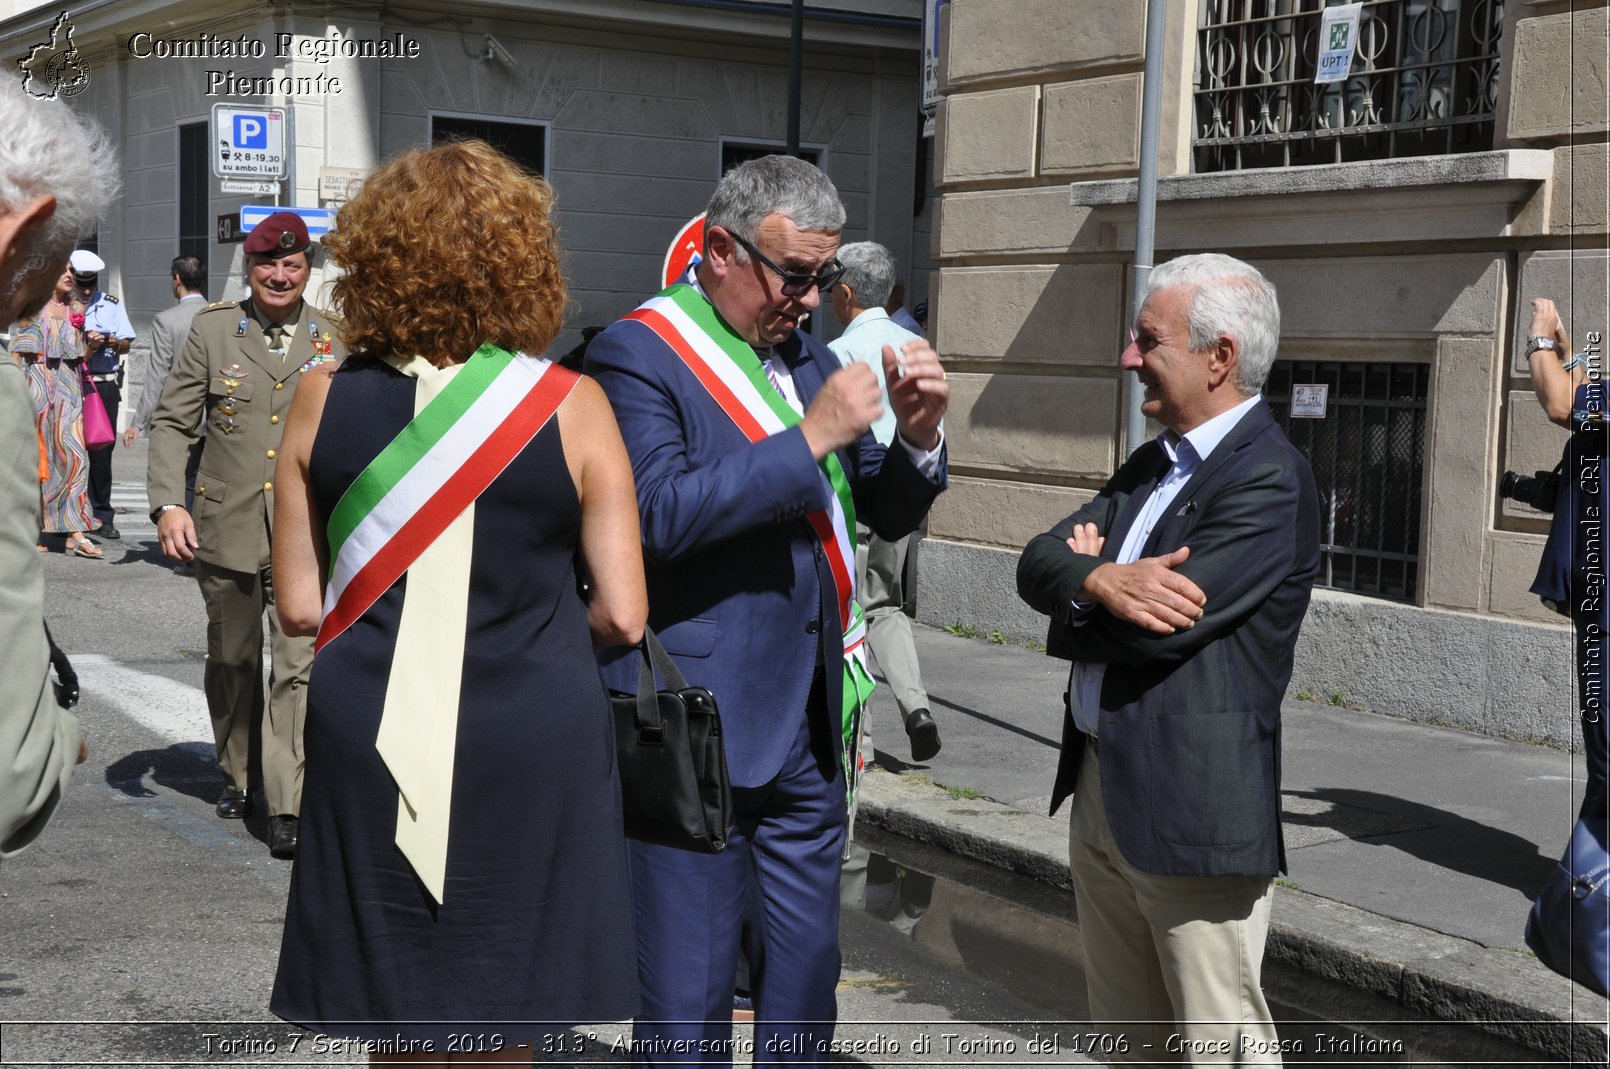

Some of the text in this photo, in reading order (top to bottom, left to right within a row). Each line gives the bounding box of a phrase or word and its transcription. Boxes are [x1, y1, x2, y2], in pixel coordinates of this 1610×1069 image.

[1321, 54, 1349, 68] UPT 1
[240, 118, 261, 146] P
[235, 164, 258, 172] ambo
[264, 165, 279, 173] lati
[259, 185, 271, 193] A2
